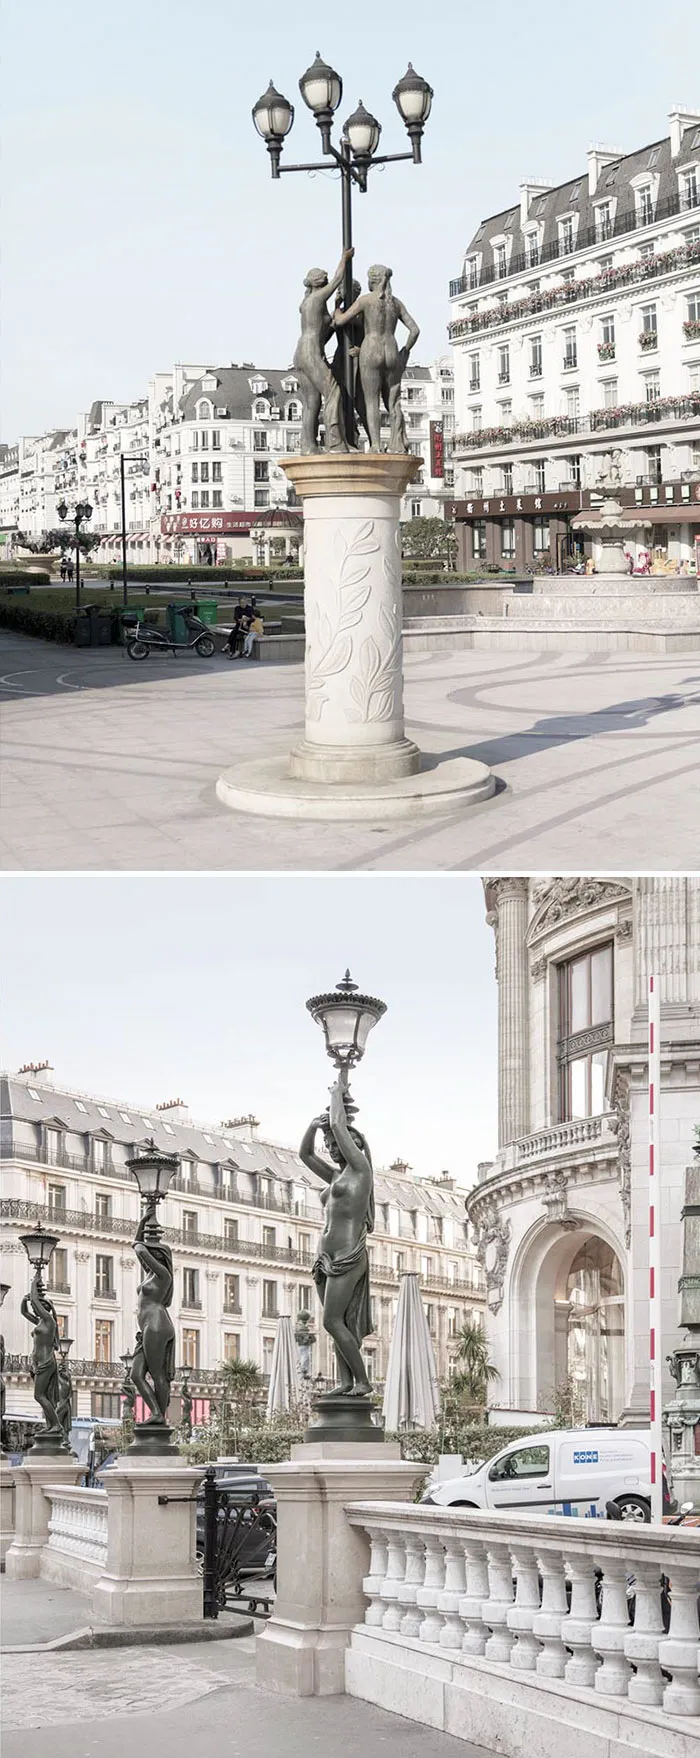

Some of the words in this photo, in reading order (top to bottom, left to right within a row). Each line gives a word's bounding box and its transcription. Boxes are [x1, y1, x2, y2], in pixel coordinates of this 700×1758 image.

[189, 517, 223, 529] 好亿购
[574, 1453, 598, 1461] KONE
